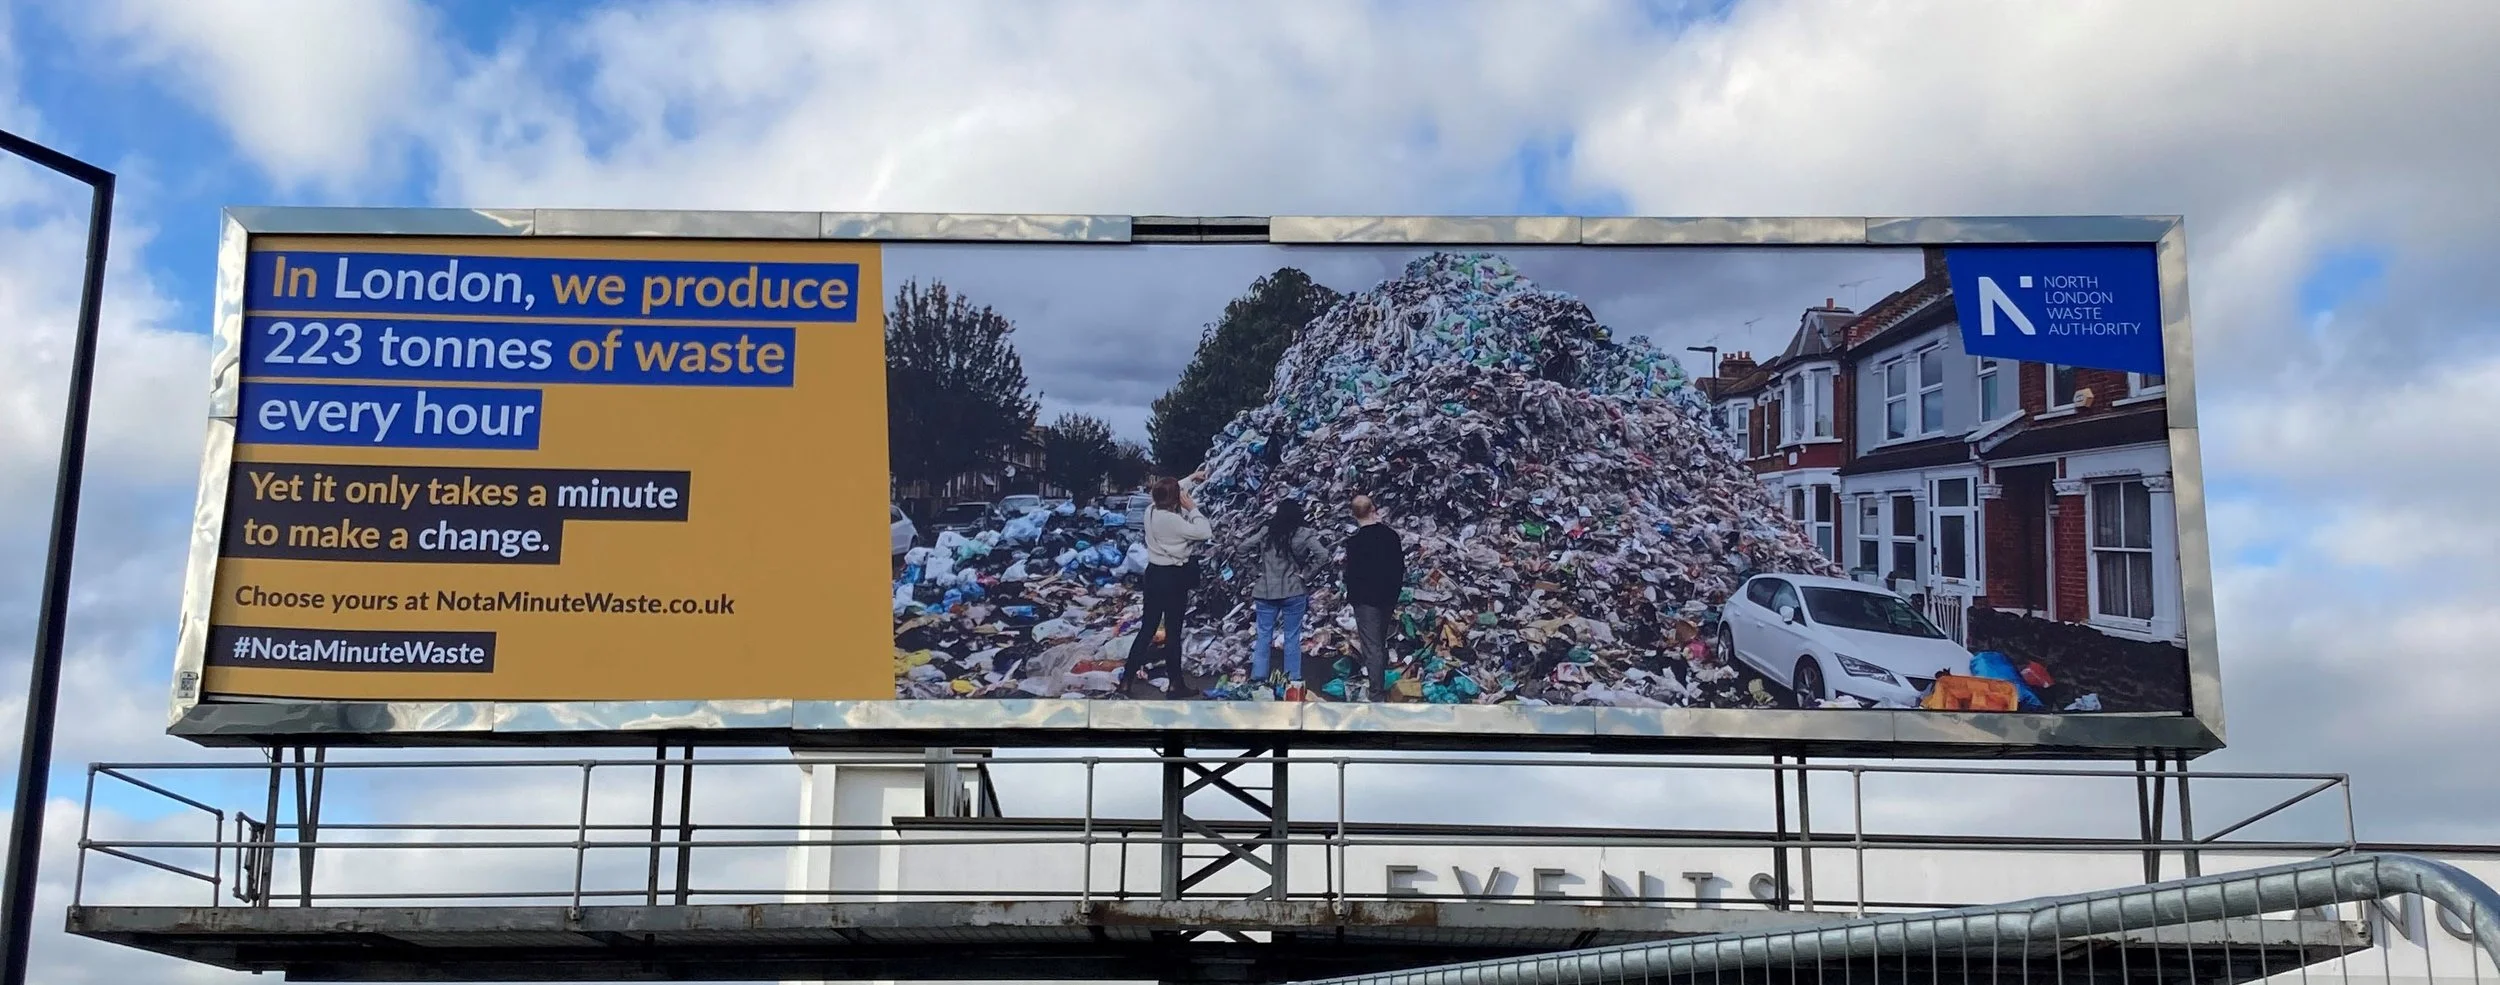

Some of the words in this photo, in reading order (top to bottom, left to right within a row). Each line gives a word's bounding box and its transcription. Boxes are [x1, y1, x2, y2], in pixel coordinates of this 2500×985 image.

[273, 256, 318, 298] In
[335, 257, 536, 311] London,
[551, 273, 625, 306] we
[642, 266, 850, 315] produce
[2044, 276, 2098, 288] NORTH
[2045, 291, 2113, 304] LONDON
[2047, 307, 2102, 320] WASTE
[2048, 322, 2141, 336] AUTHORITY
[264, 322, 363, 366] 223
[379, 326, 553, 369] tonnes
[568, 328, 623, 371] of
[634, 334, 785, 374] waste
[258, 399, 401, 443] every
[414, 391, 535, 436] hour
[250, 472, 303, 502] Yet
[312, 473, 338, 503] it
[345, 474, 420, 510] only
[428, 476, 519, 507] takes
[527, 485, 547, 507] a
[558, 478, 679, 509] minute
[243, 518, 279, 546] to
[289, 518, 379, 550] make
[389, 528, 408, 550] a
[418, 520, 550, 557] change.
[234, 586, 325, 610] Choose
[332, 593, 398, 614] yours
[404, 593, 429, 612] at
[436, 590, 735, 615] NotaMinuteWaste.co.uk
[233, 636, 486, 665] #NotaMinuteWaste
